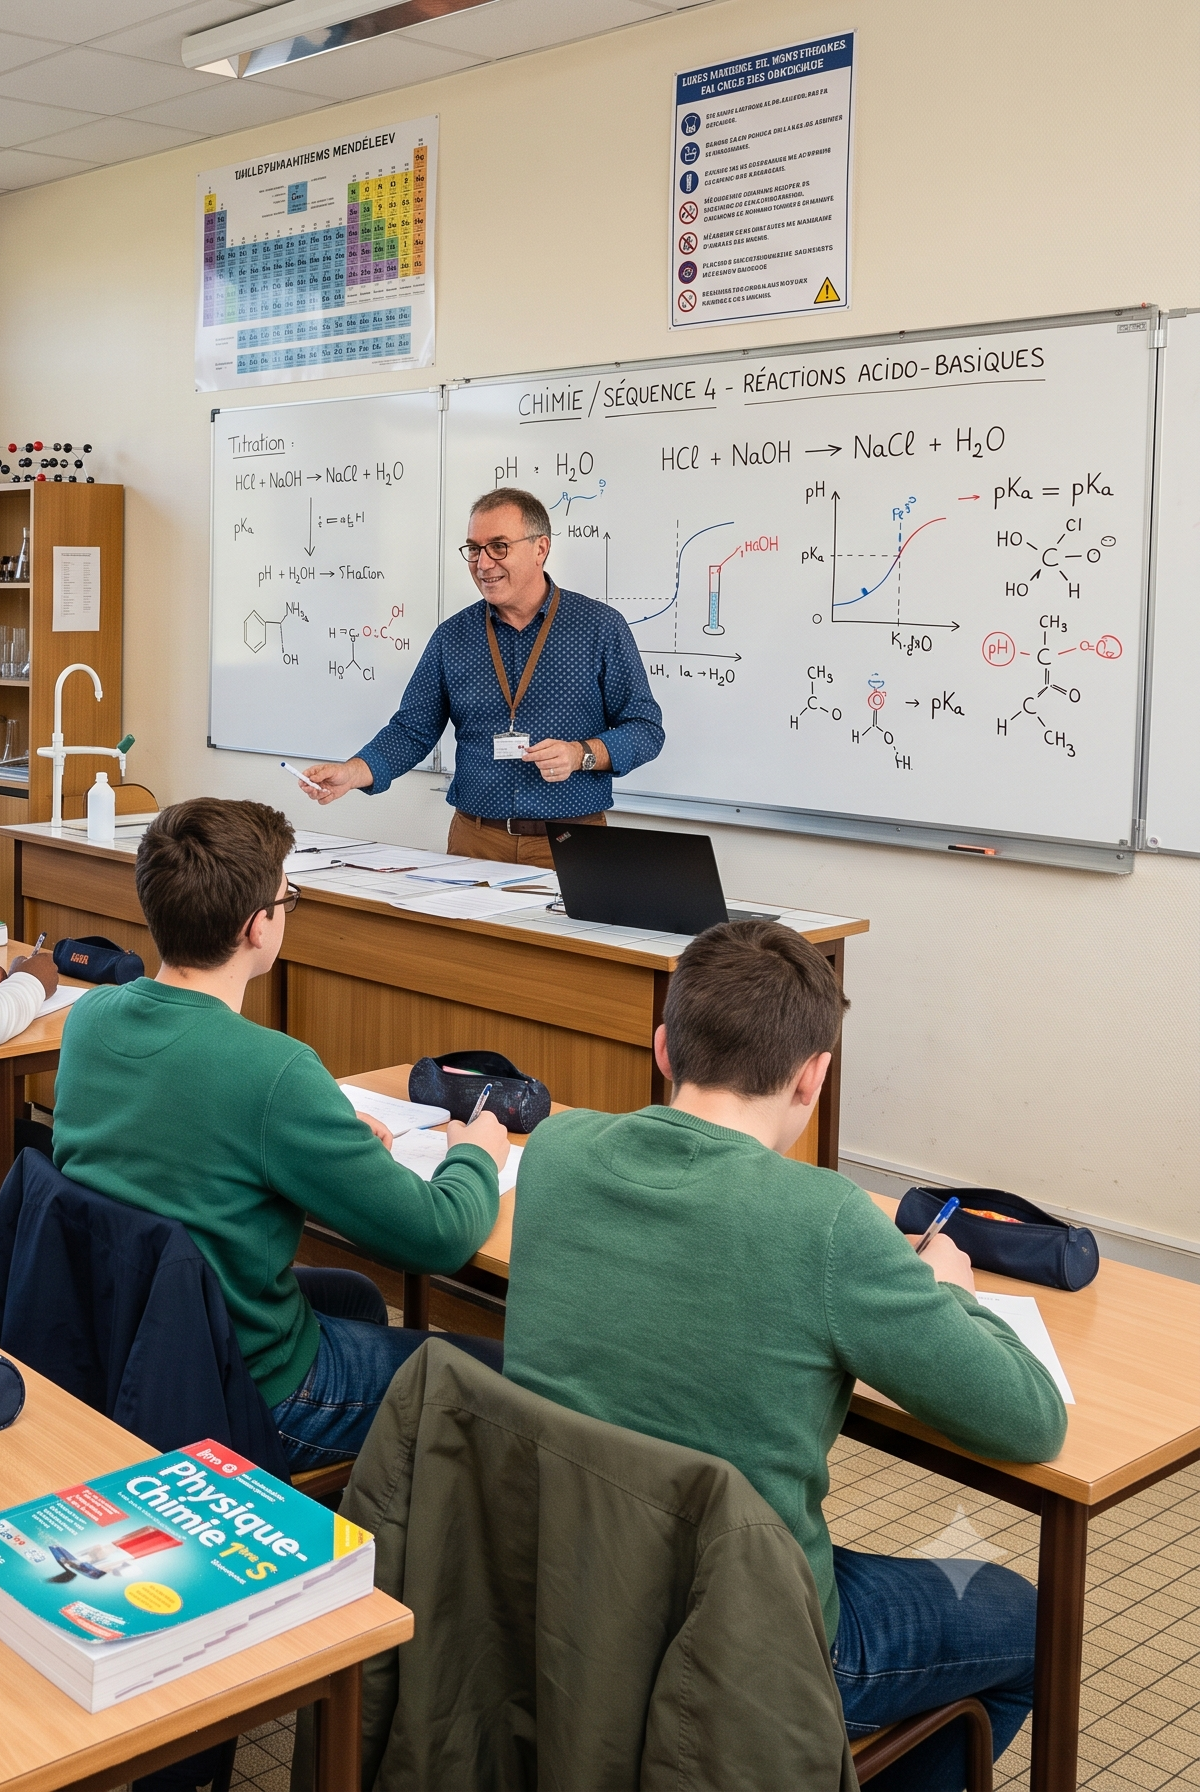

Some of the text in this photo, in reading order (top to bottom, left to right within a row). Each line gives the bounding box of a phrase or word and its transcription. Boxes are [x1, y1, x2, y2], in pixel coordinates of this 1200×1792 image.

[333, 132, 396, 157] MENDÉLEEV
[519, 384, 583, 416] CHIMIE
[604, 379, 696, 407] SÉQUENCE
[704, 378, 716, 400] 4
[743, 366, 846, 393] RÉACTIONS
[857, 347, 1046, 383] ACIDO-BASIQUES
[228, 434, 284, 452] Titration
[662, 445, 699, 471] HCl
[733, 440, 790, 466] NaOH
[854, 431, 914, 459] NaCl
[236, 474, 255, 490] HCl
[270, 470, 301, 488] NaOH
[326, 465, 357, 483] NaCl
[495, 456, 517, 486] pH
[806, 481, 824, 504] pH
[994, 476, 1033, 510] pKa
[1072, 472, 1114, 507] pKa
[998, 531, 1022, 547] HO
[802, 546, 824, 564] pKa
[259, 565, 271, 587] pH
[1005, 581, 1029, 597] HO
[1069, 583, 1079, 599] H
[988, 639, 1007, 660] pH
[1037, 648, 1051, 665] C
[283, 653, 299, 666] OH
[363, 667, 375, 680] Cl
[806, 696, 818, 711] C
[932, 691, 965, 719] pKa
[1023, 697, 1038, 715] C
[790, 715, 798, 730] H
[997, 718, 1007, 736] H
[852, 729, 859, 744] H
[126, 1476, 226, 1548] Chimie
[159, 1461, 308, 1562] Physique-
